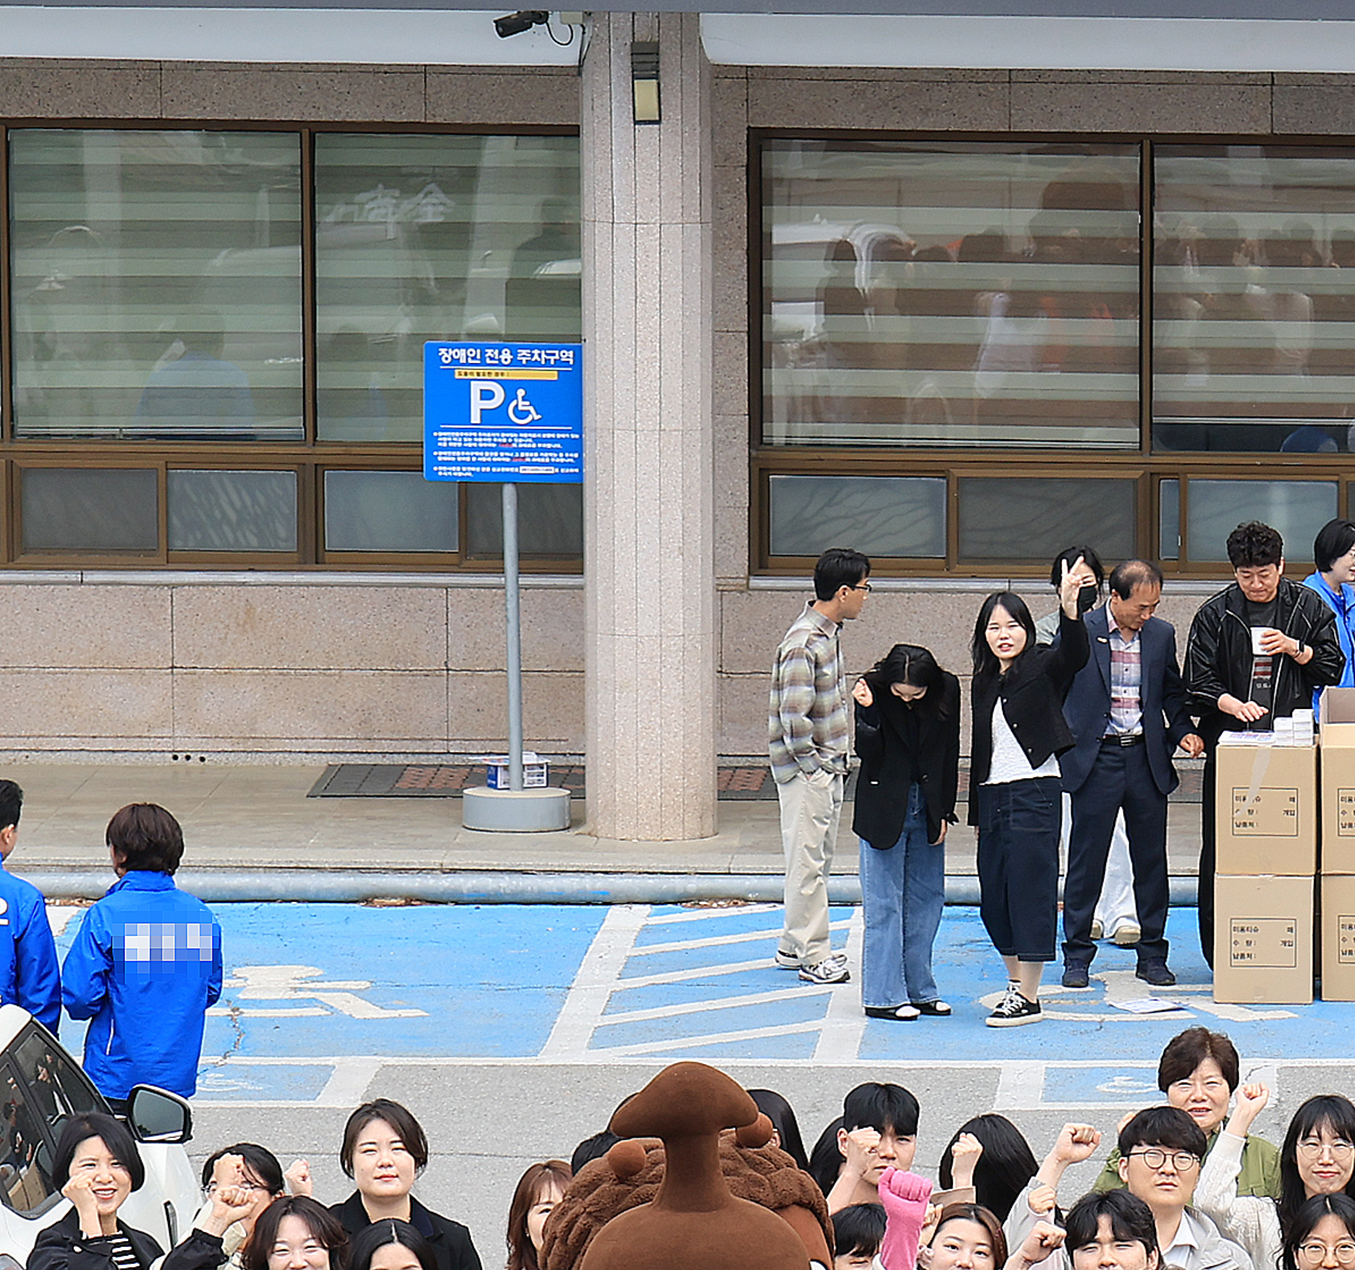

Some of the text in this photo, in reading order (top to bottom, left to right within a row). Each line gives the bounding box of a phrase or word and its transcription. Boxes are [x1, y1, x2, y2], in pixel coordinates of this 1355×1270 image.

[438, 348, 574, 365] 장애인 전용 주차구역
[470, 381, 506, 424] P
